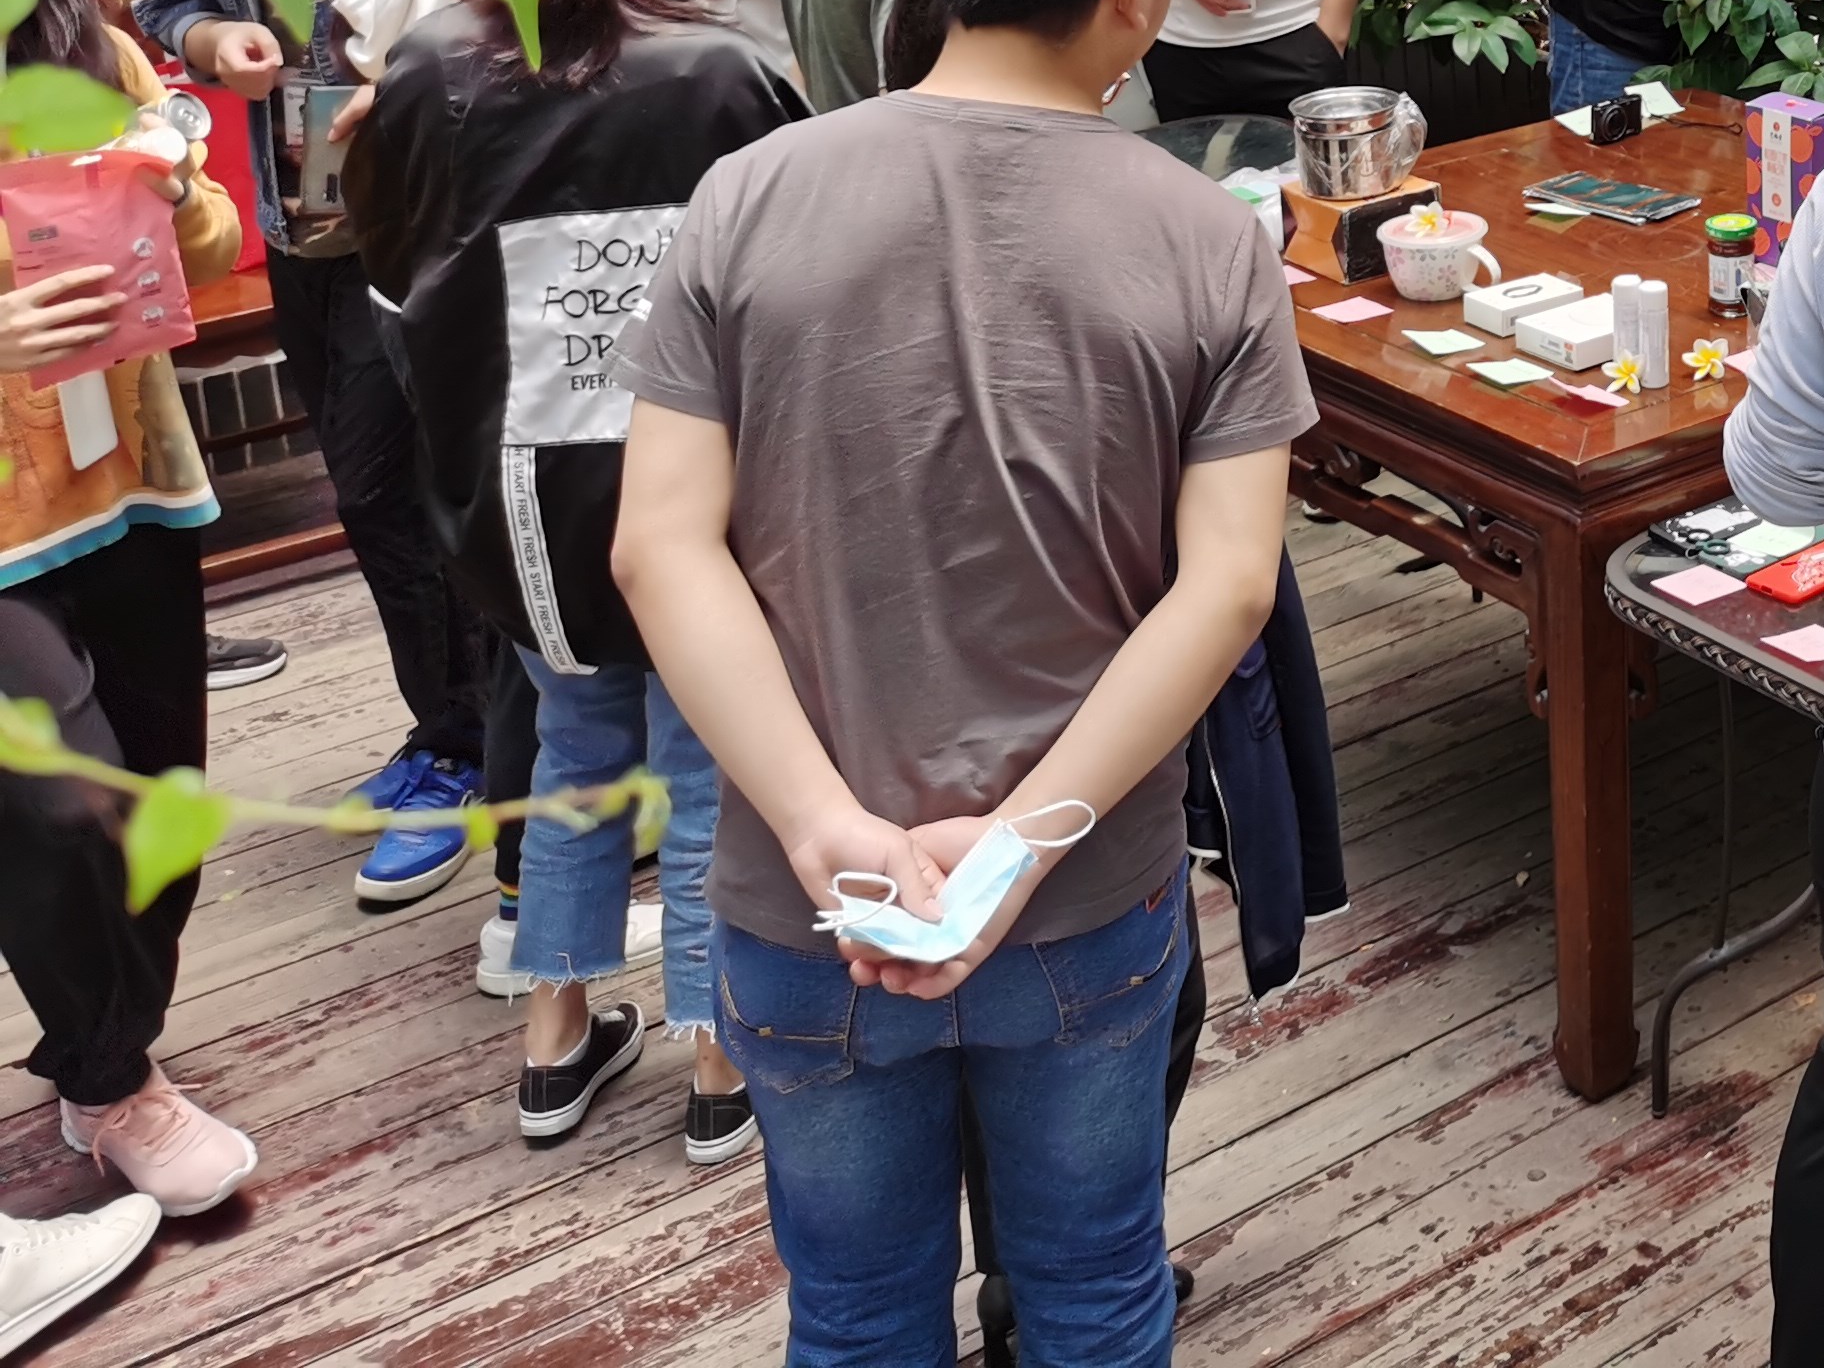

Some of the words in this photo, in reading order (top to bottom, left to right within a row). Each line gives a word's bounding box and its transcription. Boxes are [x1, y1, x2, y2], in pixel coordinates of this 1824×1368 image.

[515, 498, 532, 531] FRESH
[523, 536, 538, 569] FRESH
[530, 572, 546, 601] START
[537, 605, 554, 635] FRESH
